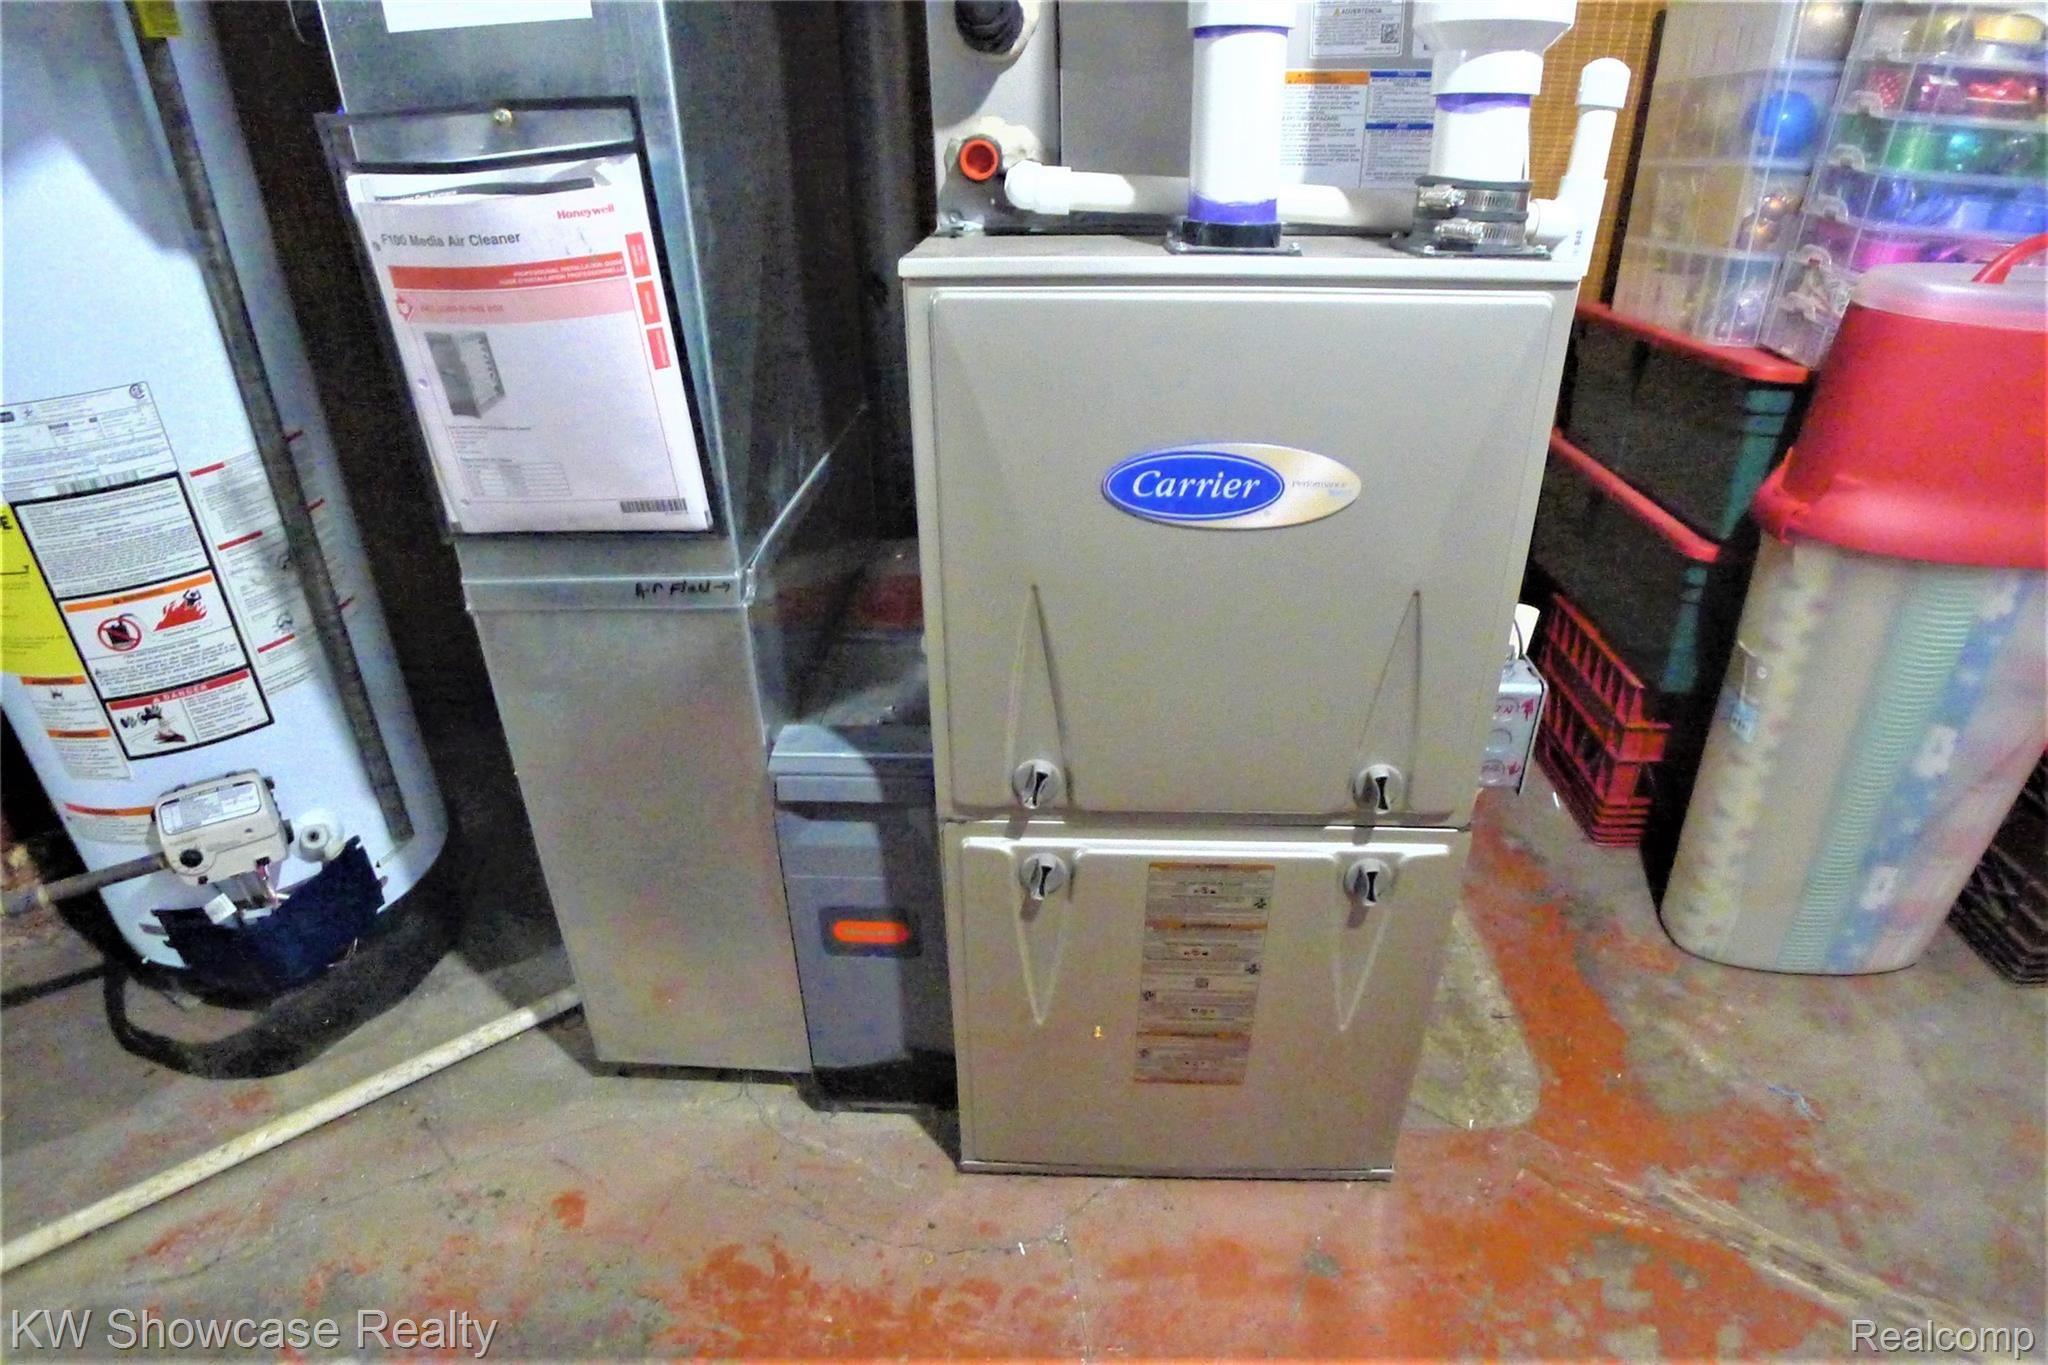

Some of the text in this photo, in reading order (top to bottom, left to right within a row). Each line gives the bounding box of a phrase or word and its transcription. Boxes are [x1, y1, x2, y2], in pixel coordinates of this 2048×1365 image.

[556, 203, 615, 219] Honeywell
[409, 235, 445, 248] Media
[448, 235, 465, 247] Air
[469, 233, 520, 247] Cleaner
[1132, 469, 1261, 499] Carrier
